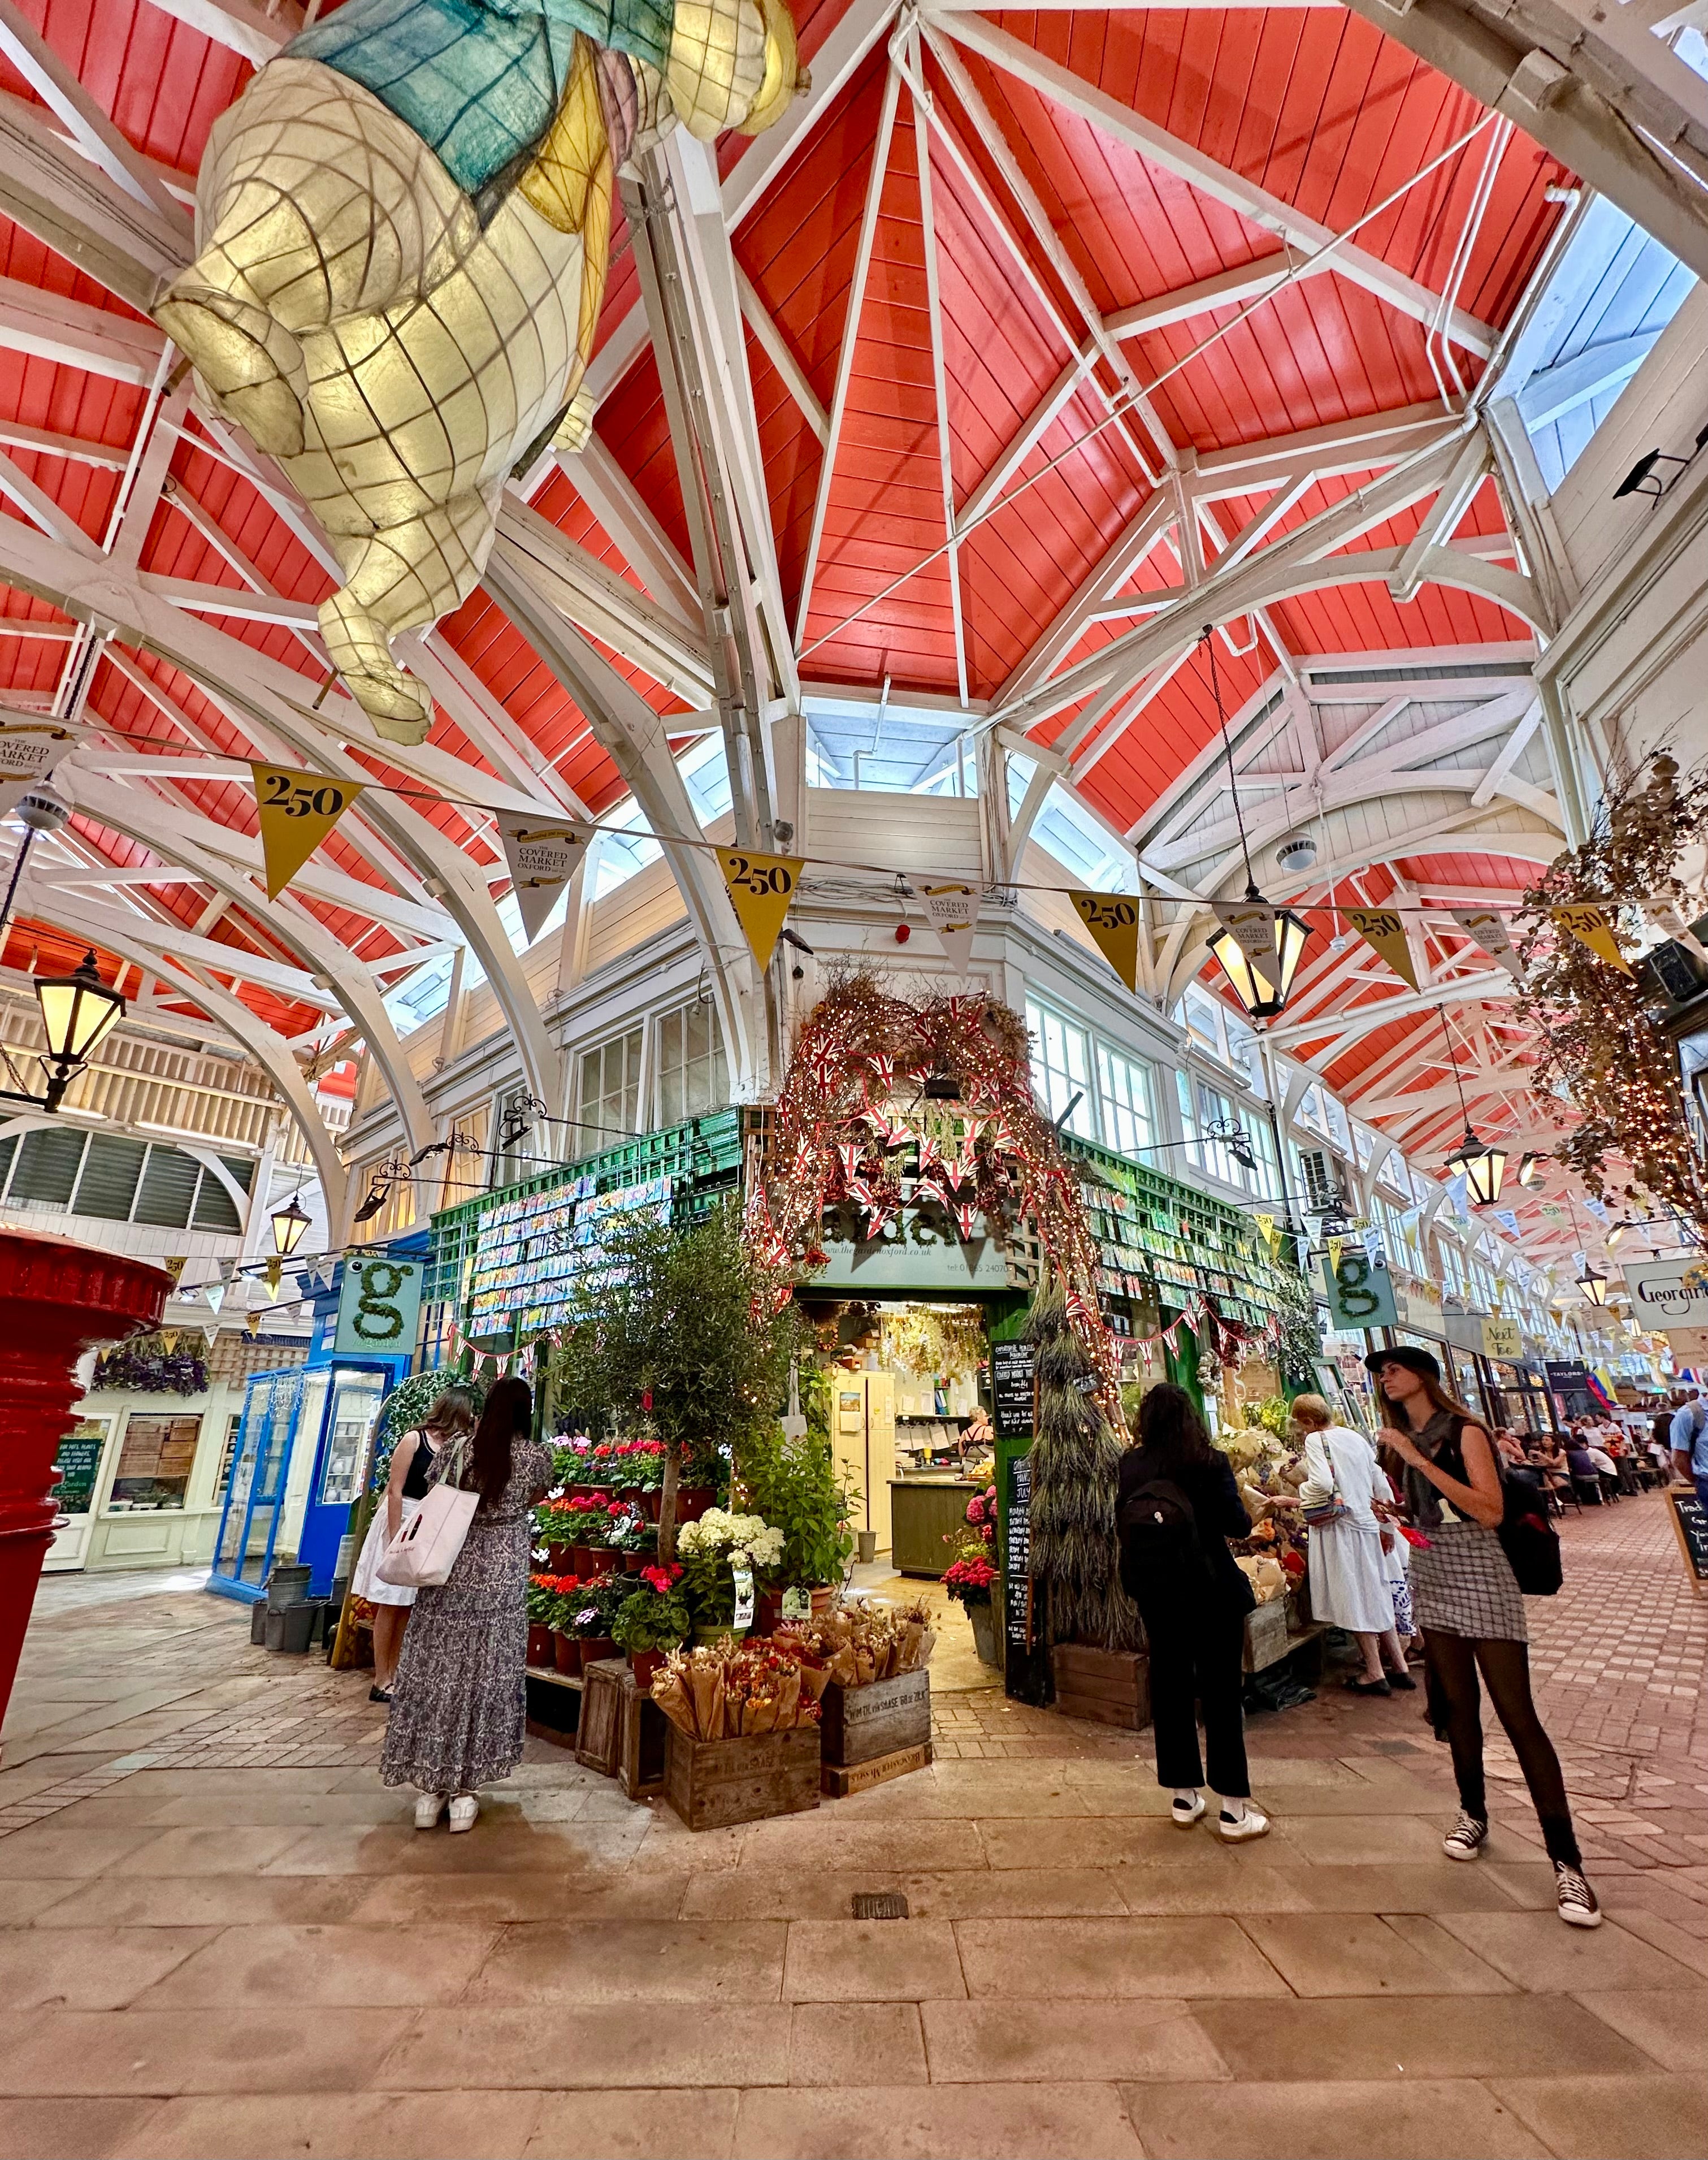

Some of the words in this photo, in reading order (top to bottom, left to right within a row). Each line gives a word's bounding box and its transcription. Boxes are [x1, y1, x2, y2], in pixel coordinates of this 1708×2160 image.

[0, 741, 49, 755] OVERED
[0, 749, 46, 763] ARKET
[262, 775, 344, 817] 250
[519, 847, 568, 860] COVERED
[517, 863, 551, 872] OXFORD
[518, 855, 567, 867] MARKET
[729, 857, 792, 895] 250
[930, 899, 968, 908] COVERED
[931, 906, 969, 914] MARKET
[1080, 899, 1136, 929] 250
[1351, 913, 1402, 938] 250
[1560, 911, 1602, 933] 250
[1541, 1206, 1560, 1216] 250
[1255, 1215, 1272, 1225] 250
[1353, 1219, 1369, 1231] 250
[1329, 1240, 1341, 1252] 250
[167, 1259, 184, 1271] 250
[267, 1259, 281, 1269] 250
[985, 1264, 1009, 1272] 24070
[1336, 1257, 1380, 1318] g
[351, 1261, 414, 1341] g
[247, 1315, 261, 1323] 250
[1486, 1327, 1515, 1341] Next
[1491, 1343, 1514, 1356] Too
[1017, 1486, 1031, 1499] JULY
